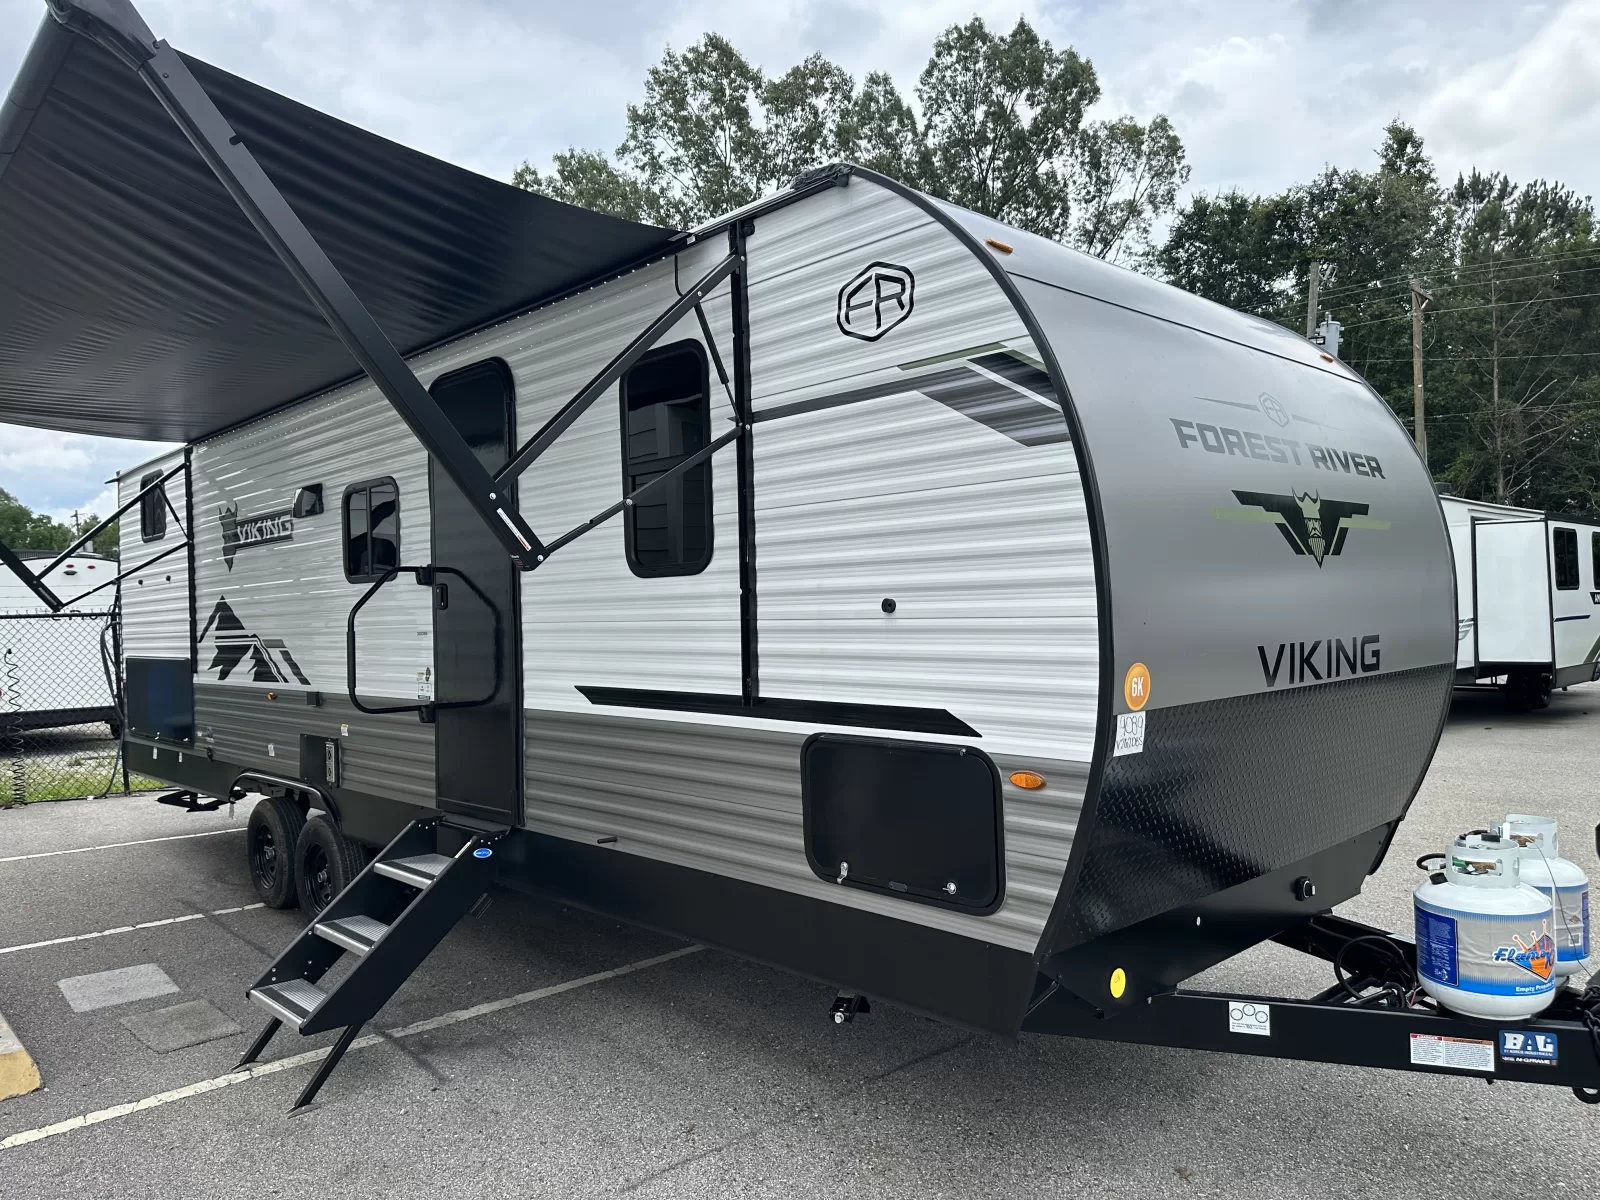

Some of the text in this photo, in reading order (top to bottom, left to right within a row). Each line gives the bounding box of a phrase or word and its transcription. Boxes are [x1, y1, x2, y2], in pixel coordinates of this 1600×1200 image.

[1168, 416, 1387, 480] FOREST RIVER
[236, 514, 292, 544] VIKING
[1256, 633, 1381, 688] VIKING
[1131, 676, 1145, 698] 6K
[1503, 1032, 1554, 1053] BAL
